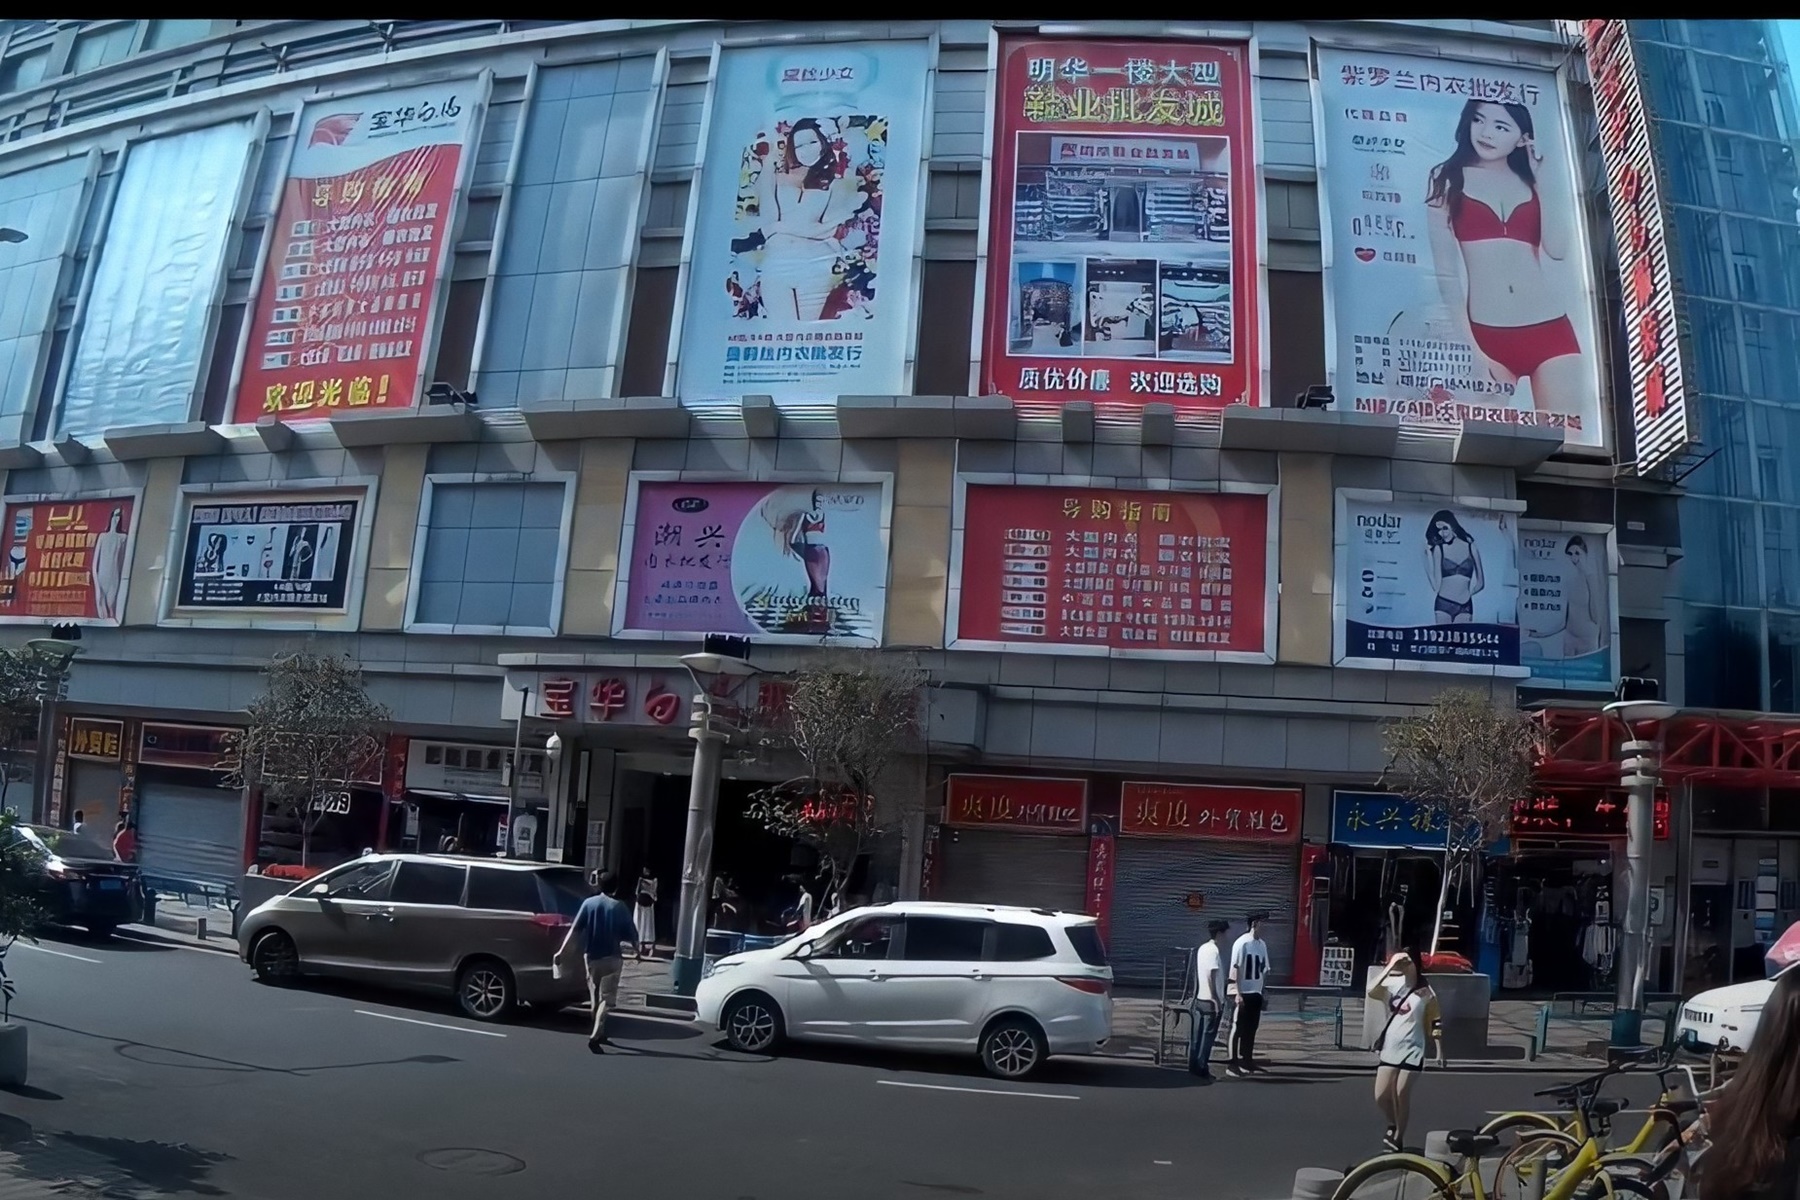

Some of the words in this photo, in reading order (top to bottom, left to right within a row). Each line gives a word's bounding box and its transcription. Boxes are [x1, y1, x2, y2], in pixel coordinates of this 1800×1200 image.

[1341, 65, 1540, 106] 紫罗兰内衣批发行
